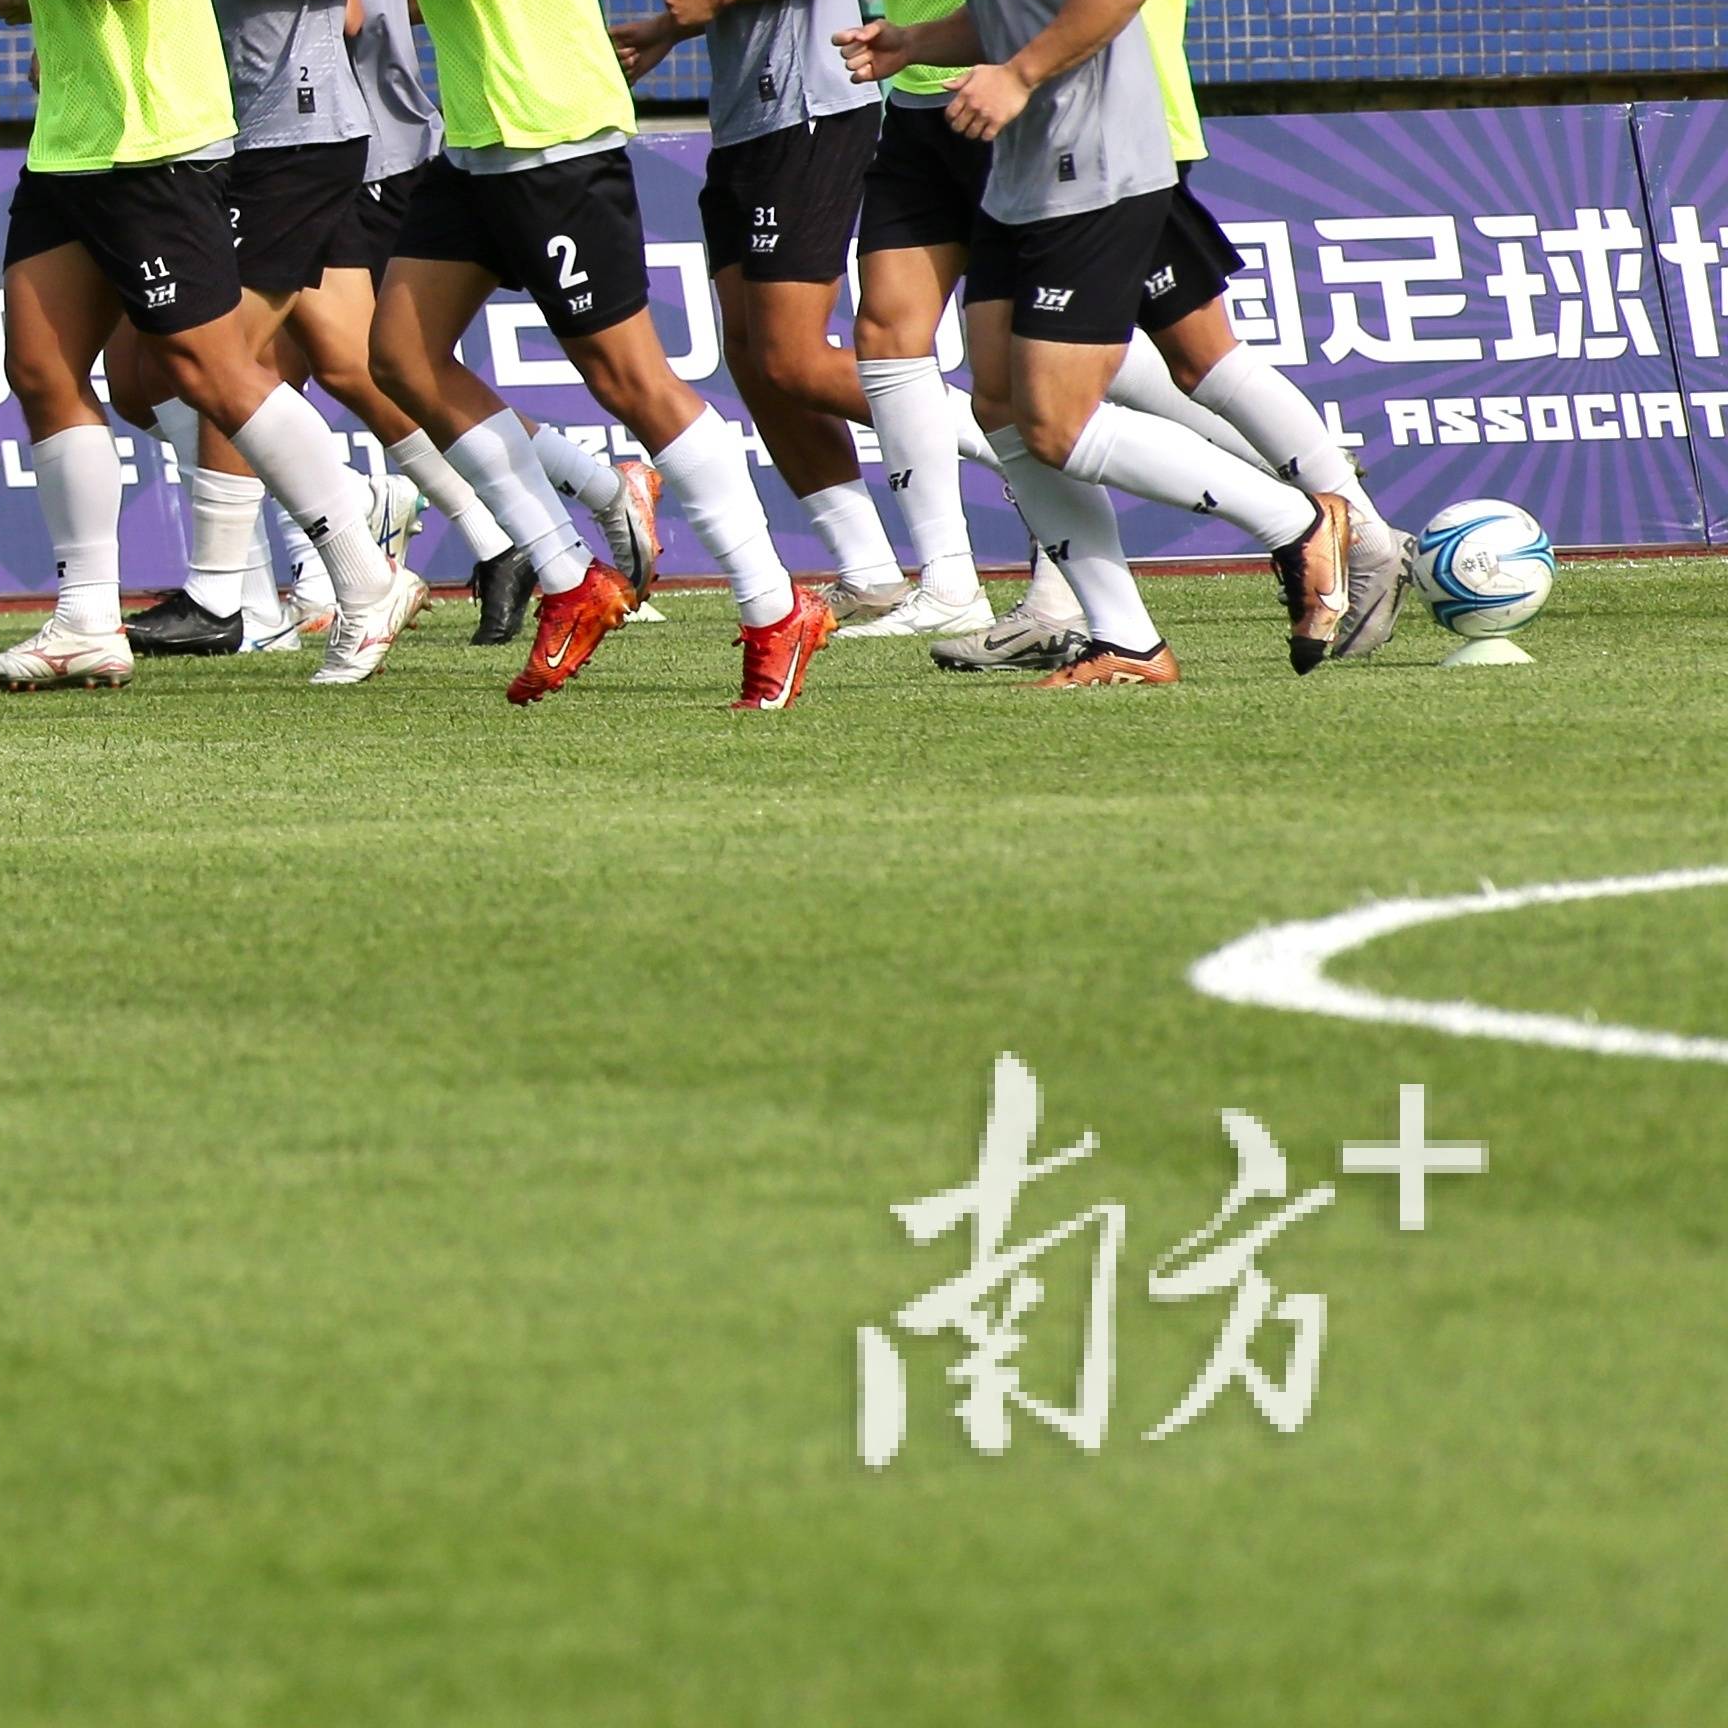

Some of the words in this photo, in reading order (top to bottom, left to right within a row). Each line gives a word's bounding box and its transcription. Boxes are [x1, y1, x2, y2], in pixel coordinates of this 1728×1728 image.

[300, 66, 309, 82] 2
[754, 206, 778, 227] 31
[139, 256, 171, 281] 11
[547, 234, 589, 290] 2
